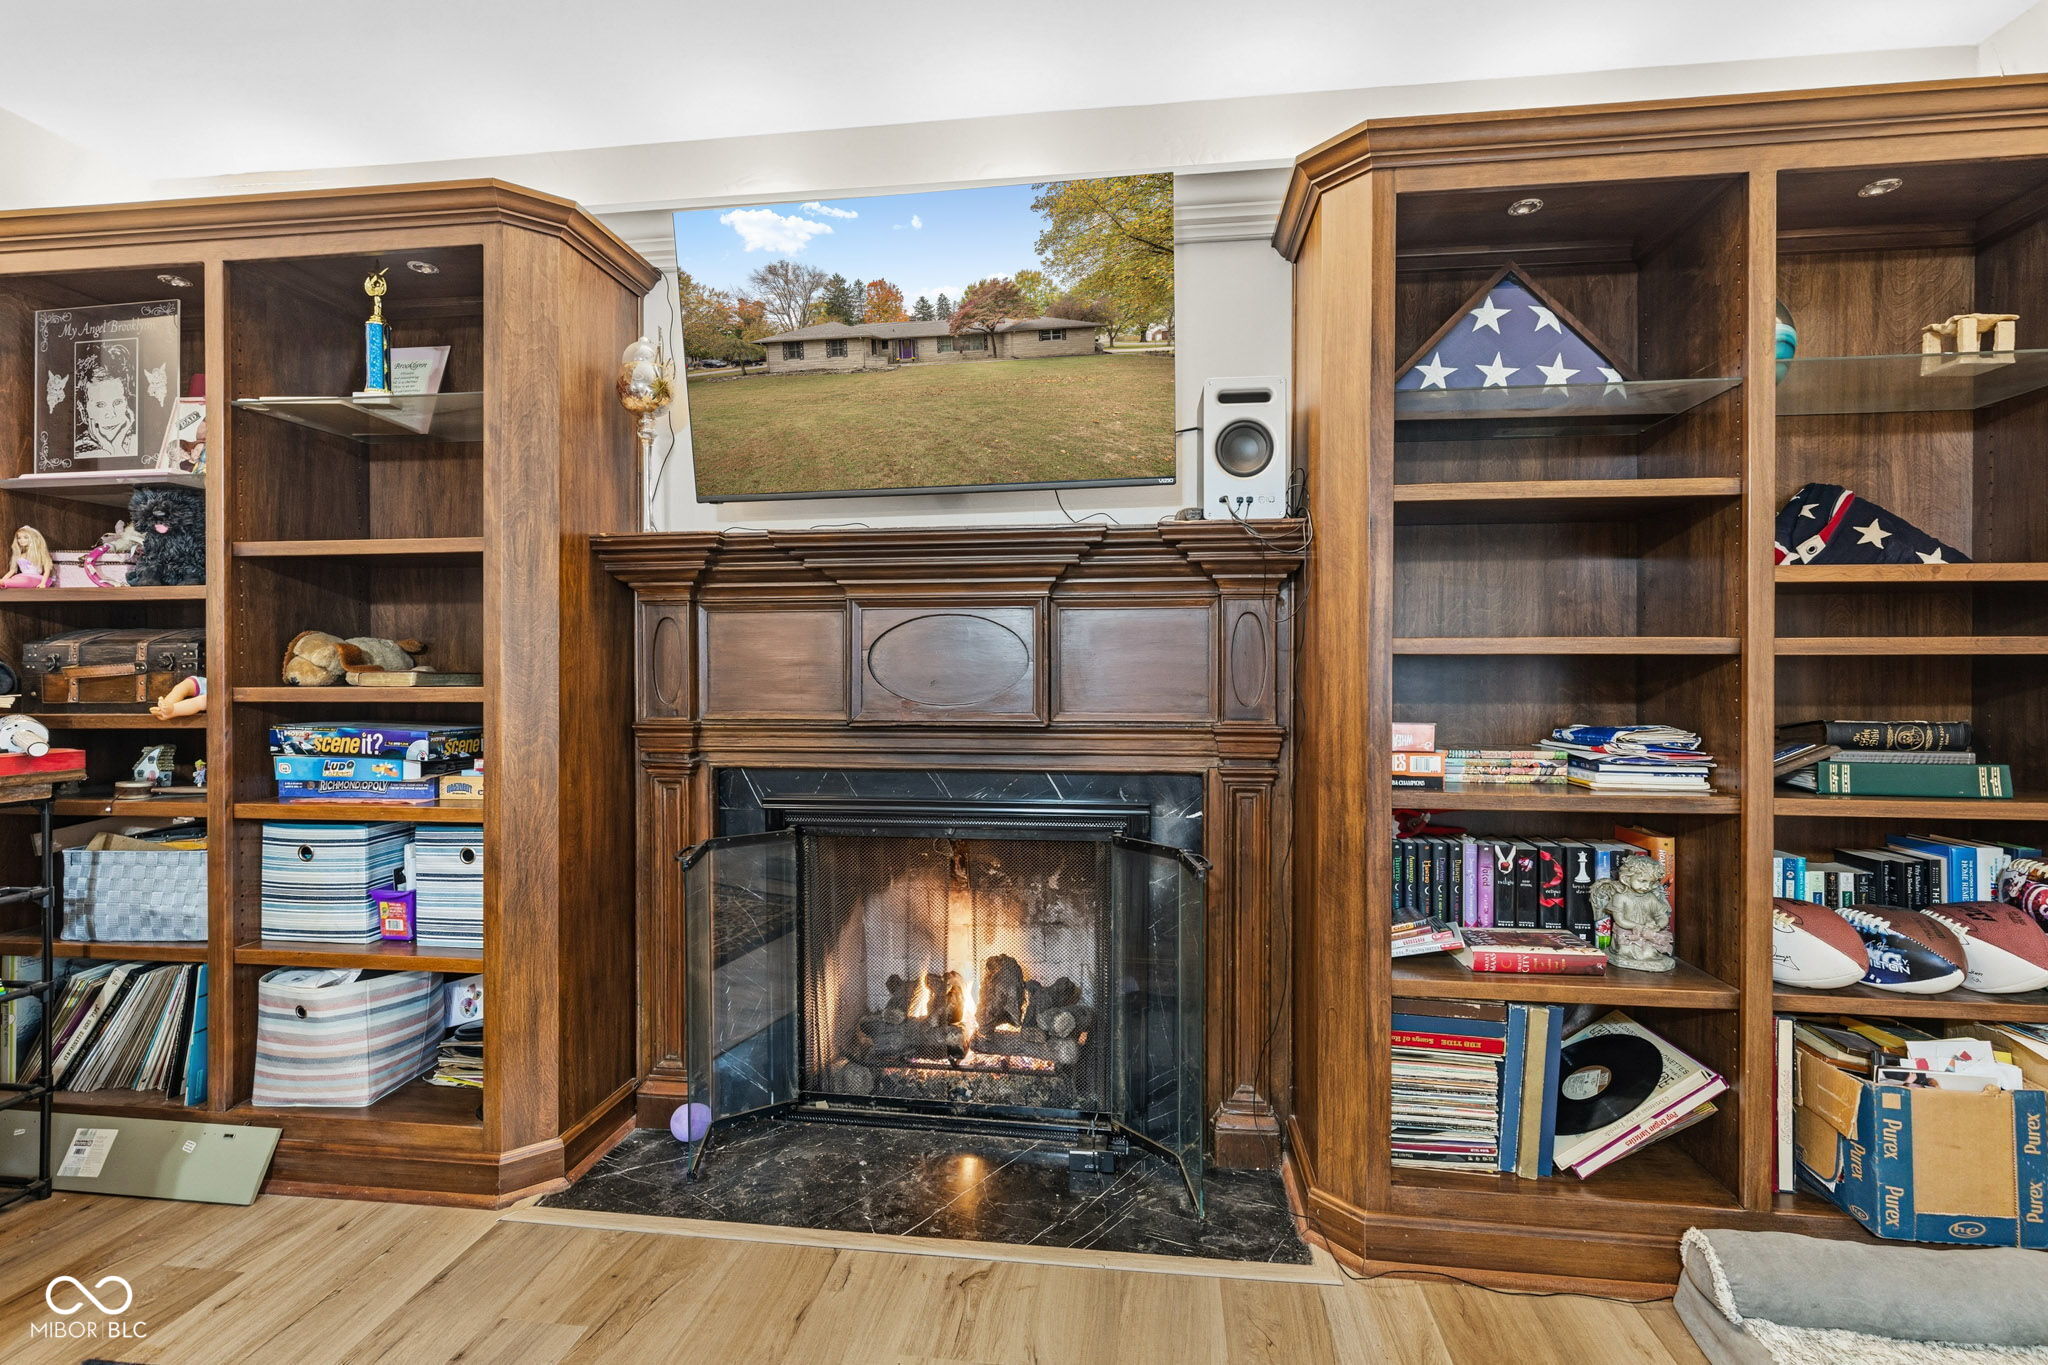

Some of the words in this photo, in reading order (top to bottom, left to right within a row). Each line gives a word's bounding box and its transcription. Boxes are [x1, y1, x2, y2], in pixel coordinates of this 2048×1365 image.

[58, 323, 77, 340] My
[78, 321, 106, 338] Angel
[313, 736, 359, 753] scene
[361, 731, 384, 755] it?
[445, 739, 479, 755] scene
[324, 761, 354, 771] LUDO
[1870, 958, 1910, 975] ILTON
[1403, 1035, 1410, 1043] of
[1412, 1036, 1434, 1044] Songs
[1441, 1039, 1462, 1047] TIDE
[1649, 1116, 1668, 1133] Organ
[1666, 1111, 1678, 1123] Pop
[1882, 1118, 1903, 1160] Purex
[2024, 1113, 2041, 1155] Purex
[1850, 1140, 1866, 1181] Purex
[1885, 1185, 1905, 1226] Purex
[2027, 1182, 2043, 1224] Purex
[1953, 1223, 1981, 1236] he
